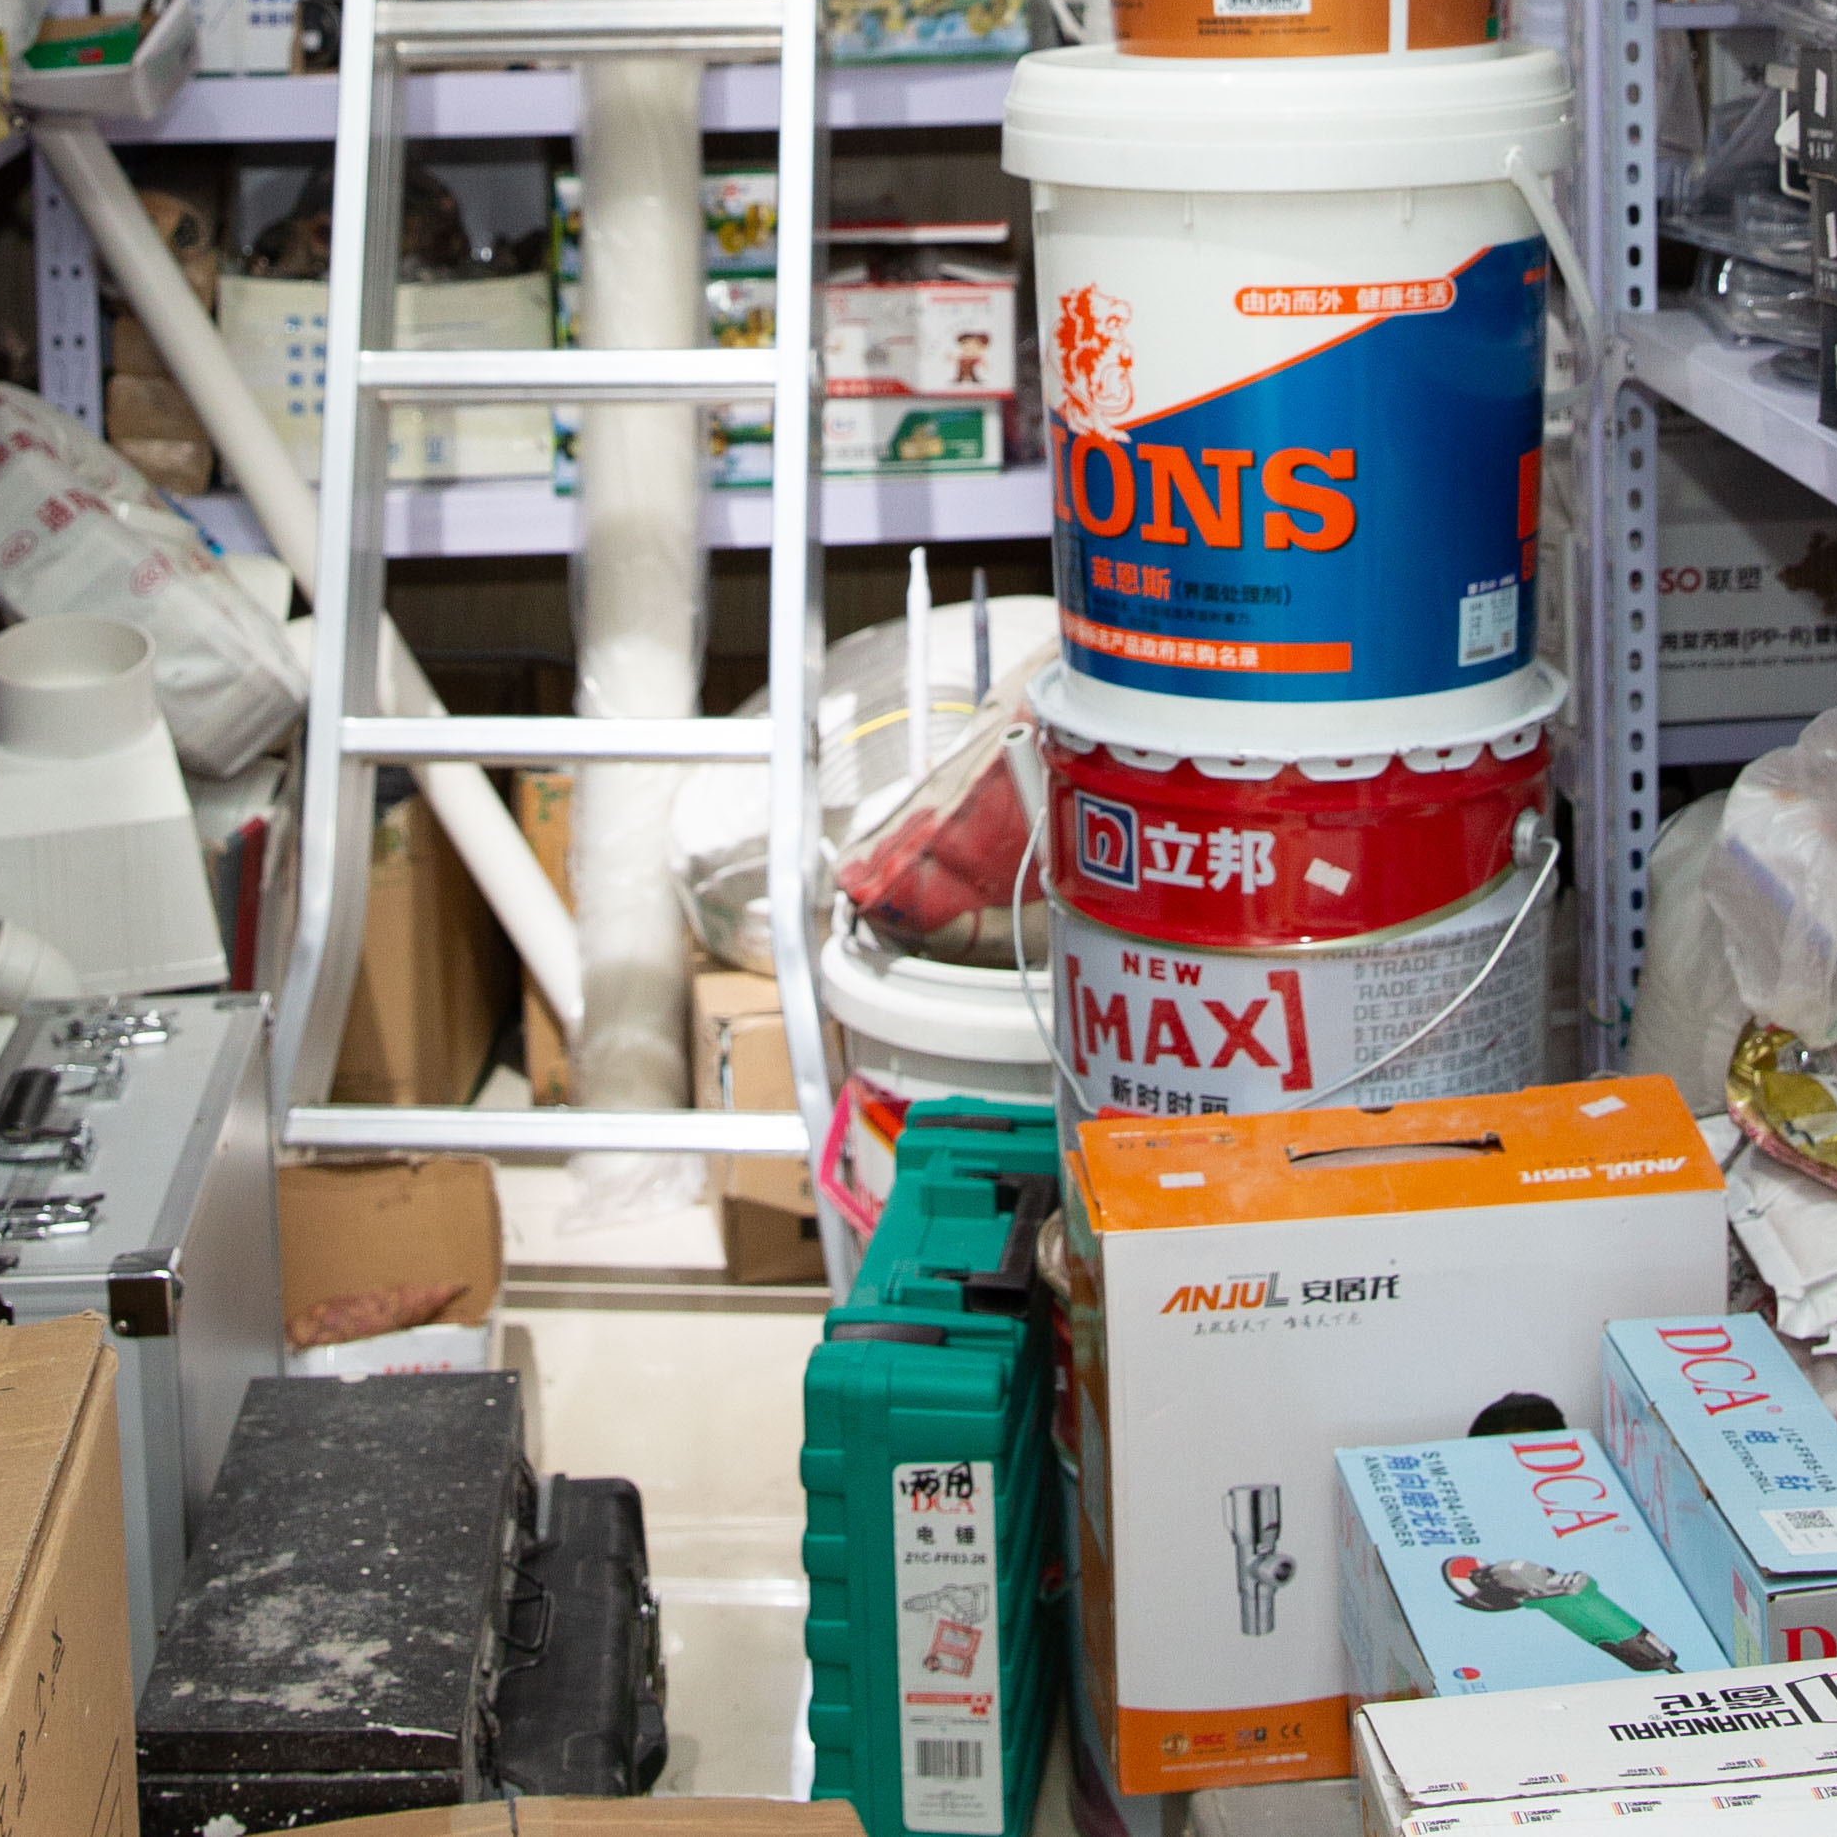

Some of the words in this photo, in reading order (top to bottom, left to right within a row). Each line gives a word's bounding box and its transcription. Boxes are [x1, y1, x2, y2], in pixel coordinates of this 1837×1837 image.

[1241, 287, 1344, 314] 由内而外
[1356, 281, 1449, 311] 健康生活
[1142, 821, 1276, 895] 立邦
[1120, 950, 1202, 987] NEW
[1160, 1271, 1290, 1315] ANJUL
[1653, 1324, 1772, 1419] DCA
[1385, 1453, 1458, 1548] 角向磨光机
[1508, 1439, 1617, 1541] DCA
